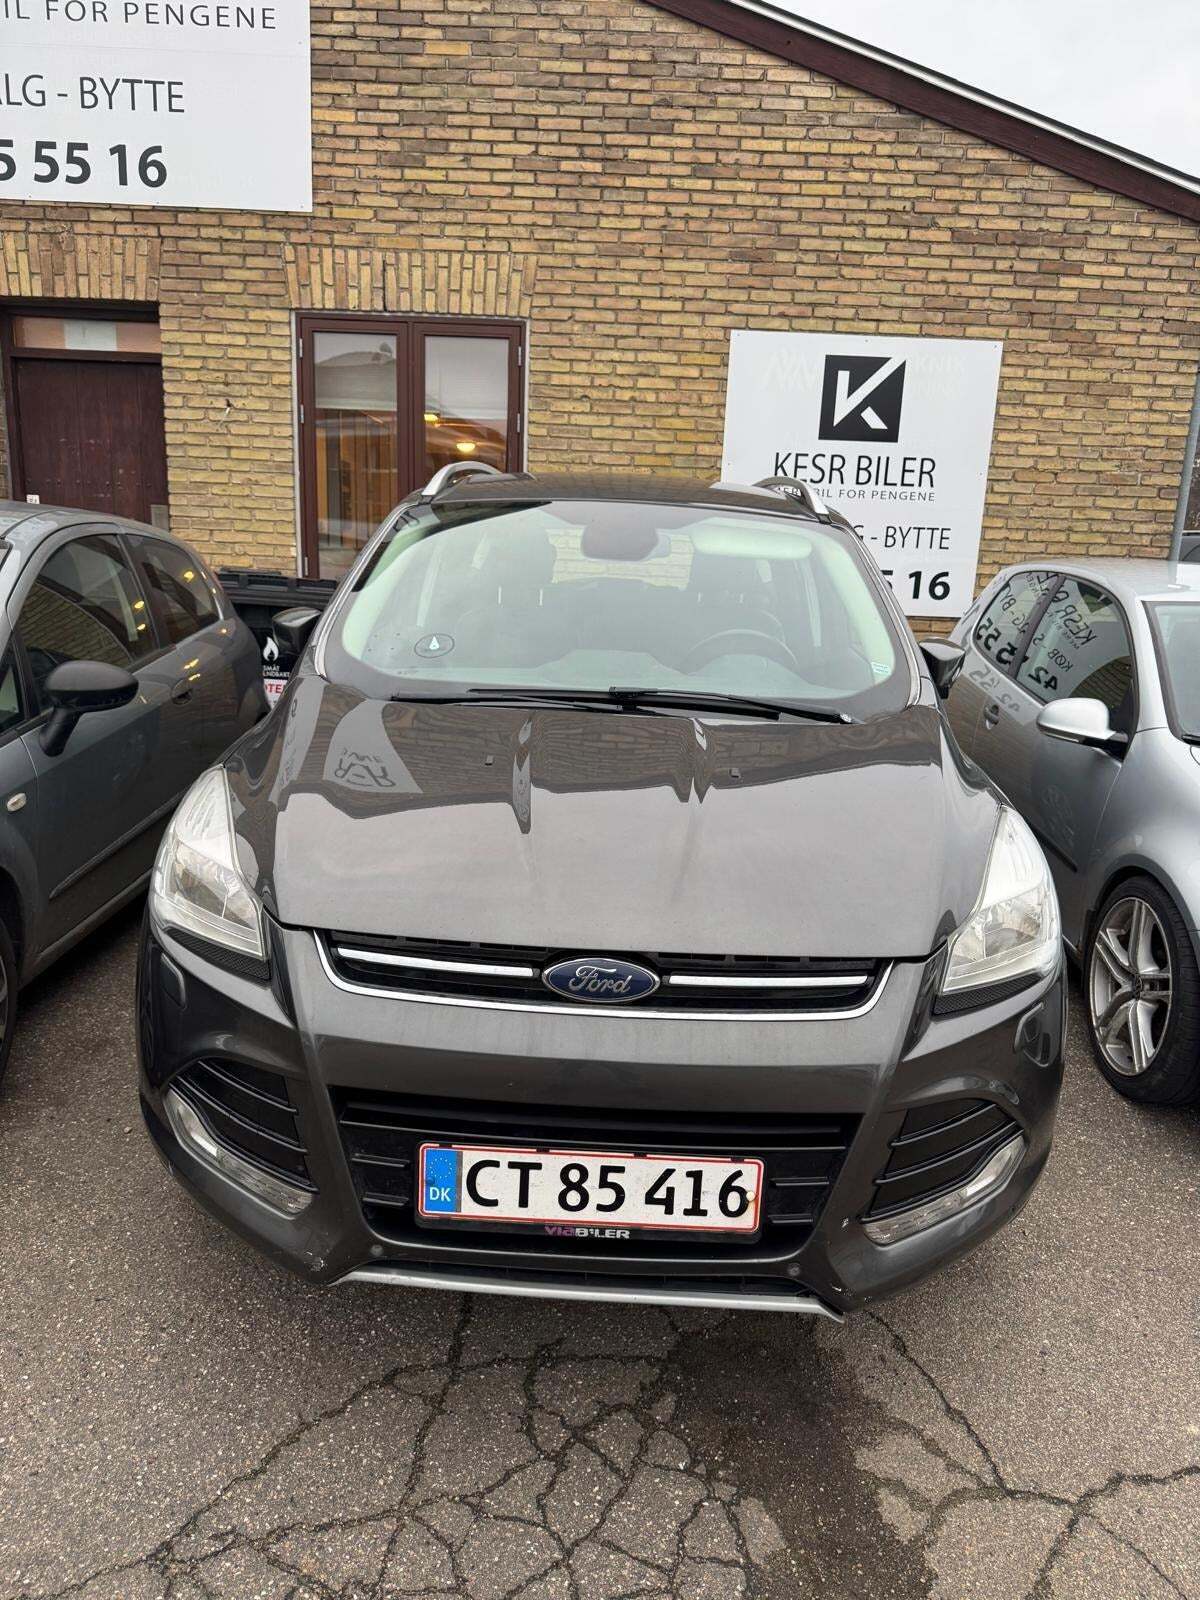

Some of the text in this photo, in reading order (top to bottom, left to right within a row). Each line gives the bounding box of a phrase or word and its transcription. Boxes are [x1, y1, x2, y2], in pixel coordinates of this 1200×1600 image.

[46, 0, 109, 23] FOR
[124, 2, 277, 30] PENGENE
[79, 76, 186, 113] BYTTE
[33, 140, 92, 185] 55
[109, 144, 168, 188] 16
[773, 451, 937, 488] KESR BILER
[838, 489, 866, 499] FOR
[871, 490, 936, 502] PENGENE
[884, 525, 951, 550] BYTTE
[908, 570, 951, 601] 16
[568, 965, 633, 993] Ford
[428, 1159, 751, 1219] DK CT 85 416
